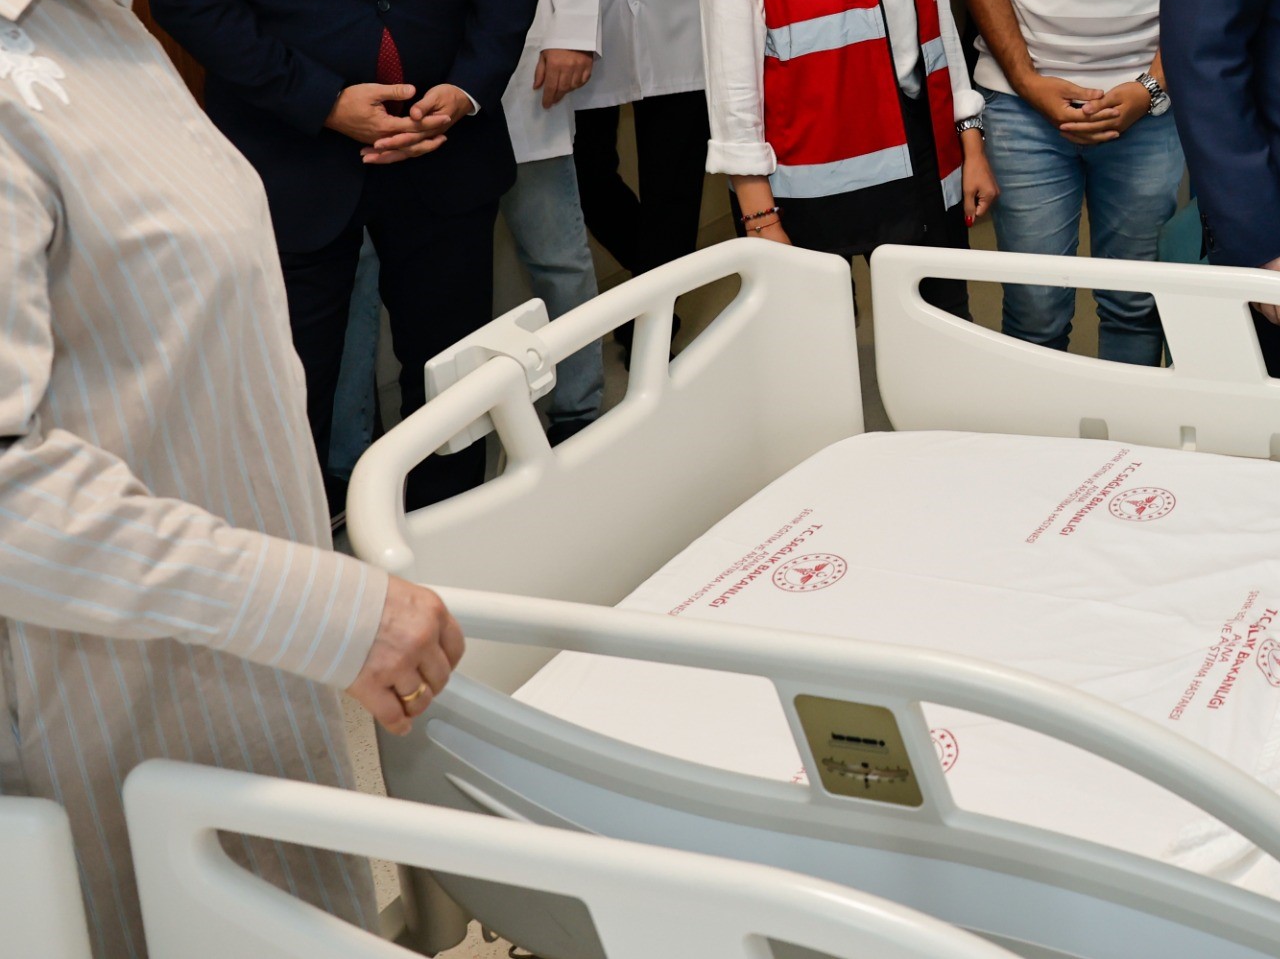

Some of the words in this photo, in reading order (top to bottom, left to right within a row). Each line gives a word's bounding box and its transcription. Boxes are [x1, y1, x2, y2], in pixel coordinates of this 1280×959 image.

[1098, 473, 1129, 498] SAĞLIK
[1025, 512, 1060, 544] HASTANESİ
[1059, 496, 1103, 536] BAKANLIĞI
[740, 551, 770, 571] ADANA
[765, 536, 805, 565] SAĞLIK
[708, 564, 770, 608] BAKANLIĞI
[1259, 608, 1278, 624] T.C
[1195, 635, 1230, 678] AŞTIRMA
[1219, 633, 1242, 664] AANA
[1206, 650, 1251, 710] BAKANLIĞI
[1168, 679, 1203, 721] HASTANESİ
